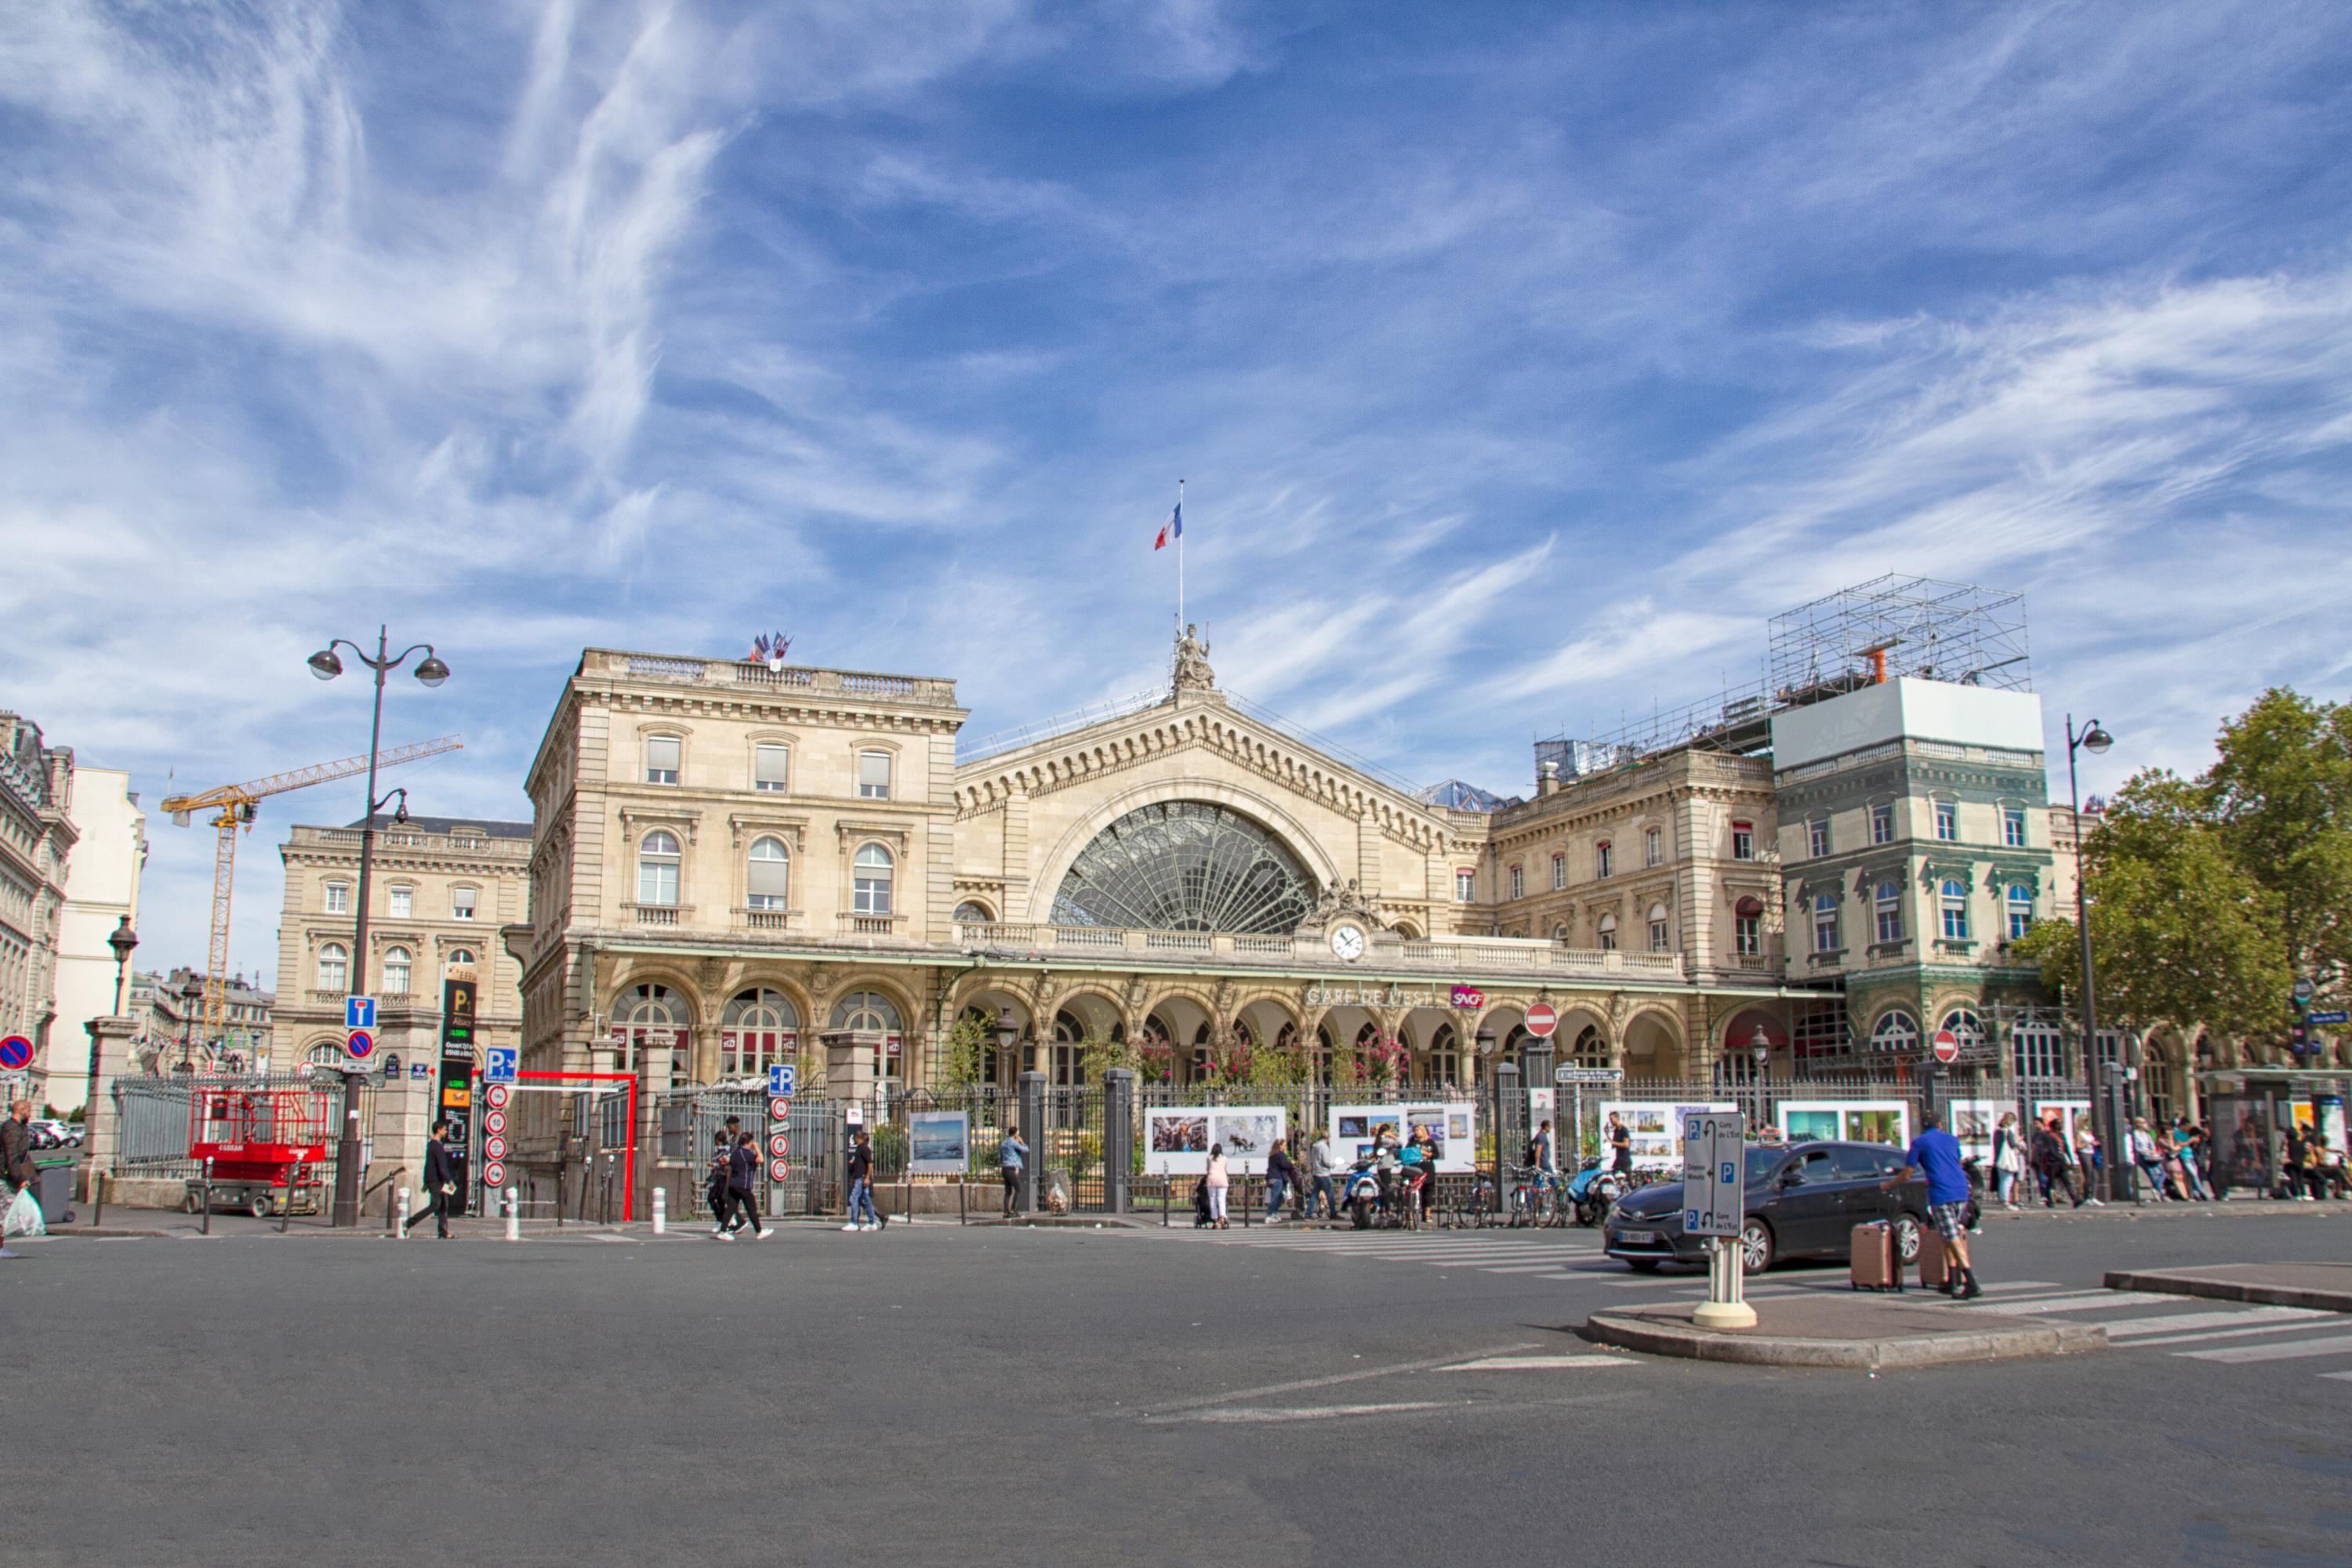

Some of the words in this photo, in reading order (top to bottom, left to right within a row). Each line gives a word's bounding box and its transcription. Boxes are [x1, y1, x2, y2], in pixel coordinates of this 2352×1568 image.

[1307, 988, 1355, 1004] GARE
[1361, 990, 1381, 1004] DE
[1453, 993, 1484, 1005] SNCF
[492, 1116, 501, 1127] 10
[1723, 1164, 1733, 1181] P
